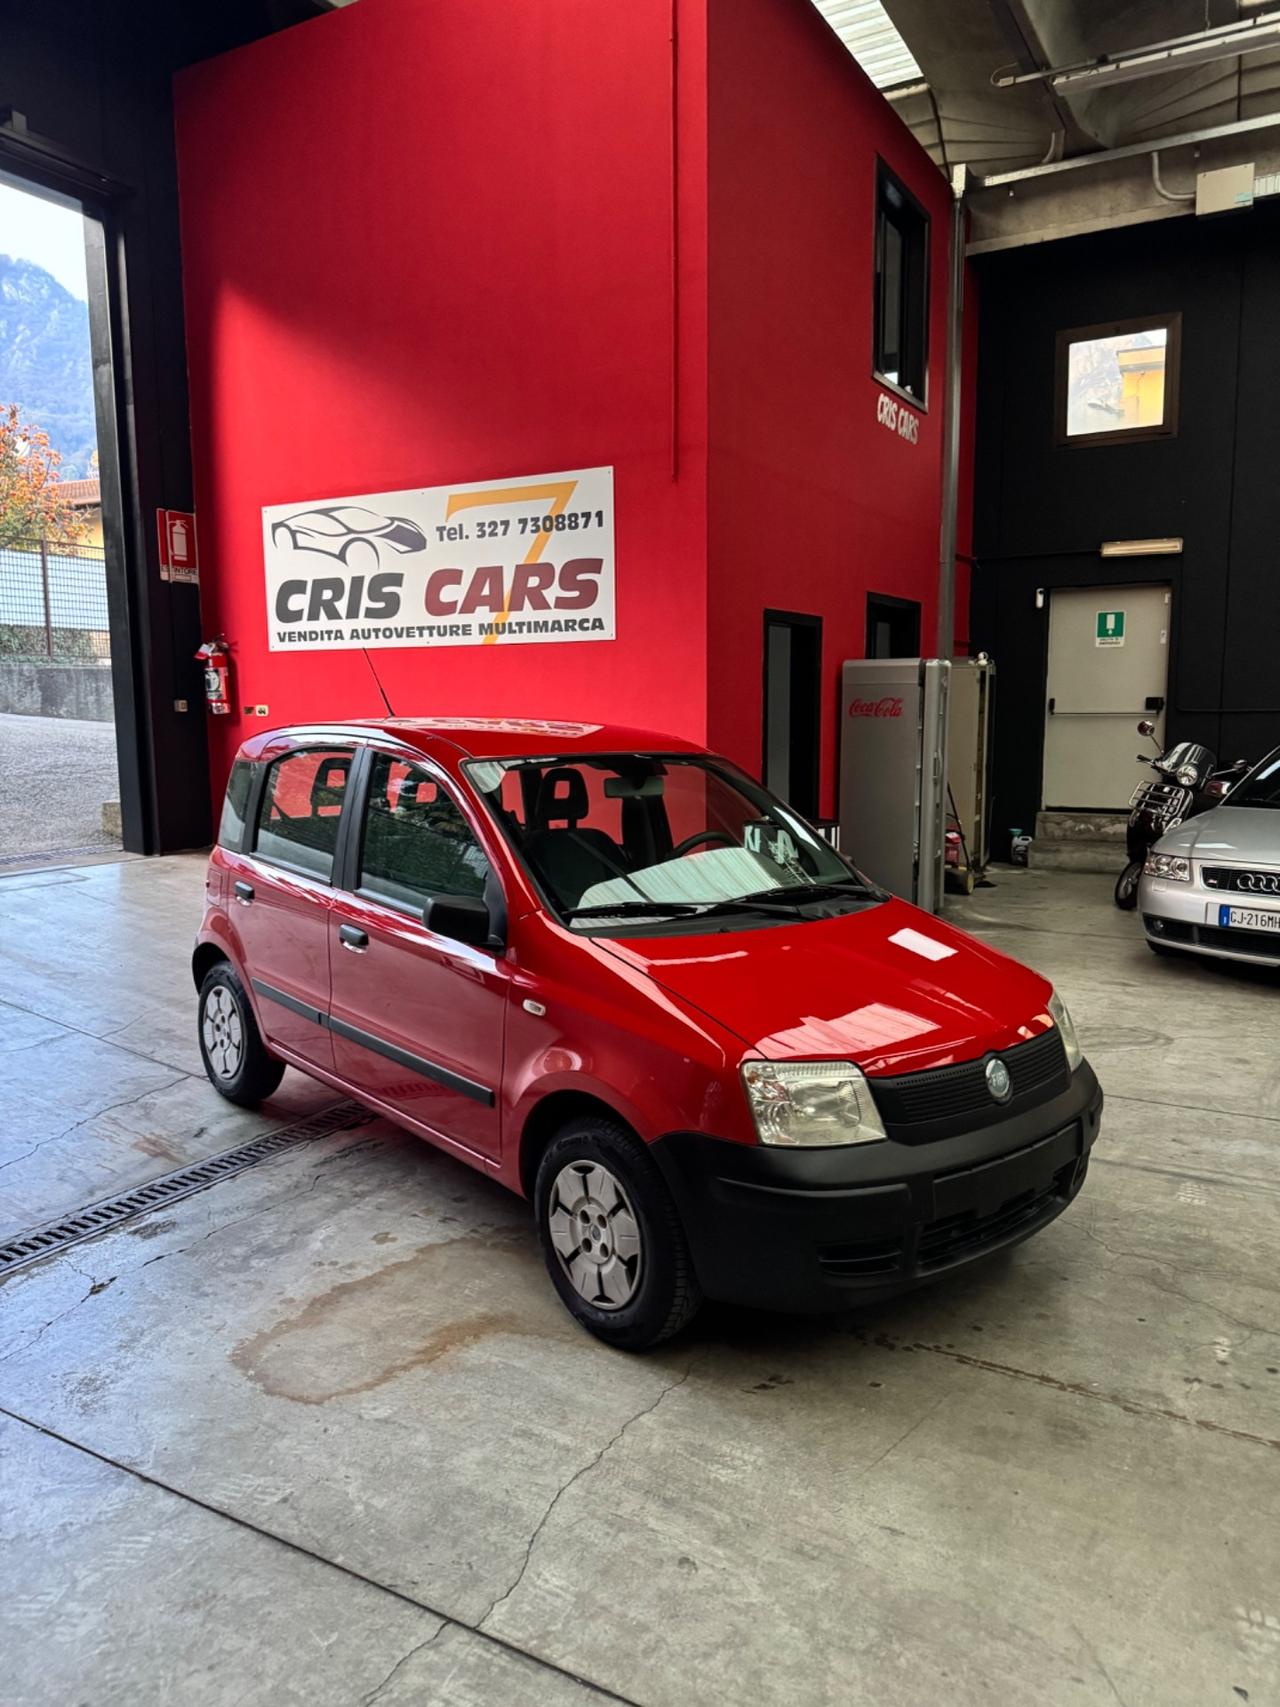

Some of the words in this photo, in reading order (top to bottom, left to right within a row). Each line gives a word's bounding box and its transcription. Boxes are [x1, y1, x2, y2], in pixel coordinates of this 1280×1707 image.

[877, 393, 898, 431] CRIS
[898, 408, 920, 445] CARS
[436, 525, 470, 542] Tel.
[476, 519, 510, 539] 327
[518, 510, 604, 535] 7308871
[275, 572, 404, 623] CRIS
[424, 557, 604, 617] CARS
[277, 629, 345, 643] VENDITA
[350, 623, 472, 641] AUTOVETTURE
[478, 617, 605, 636] MULTIMARCA
